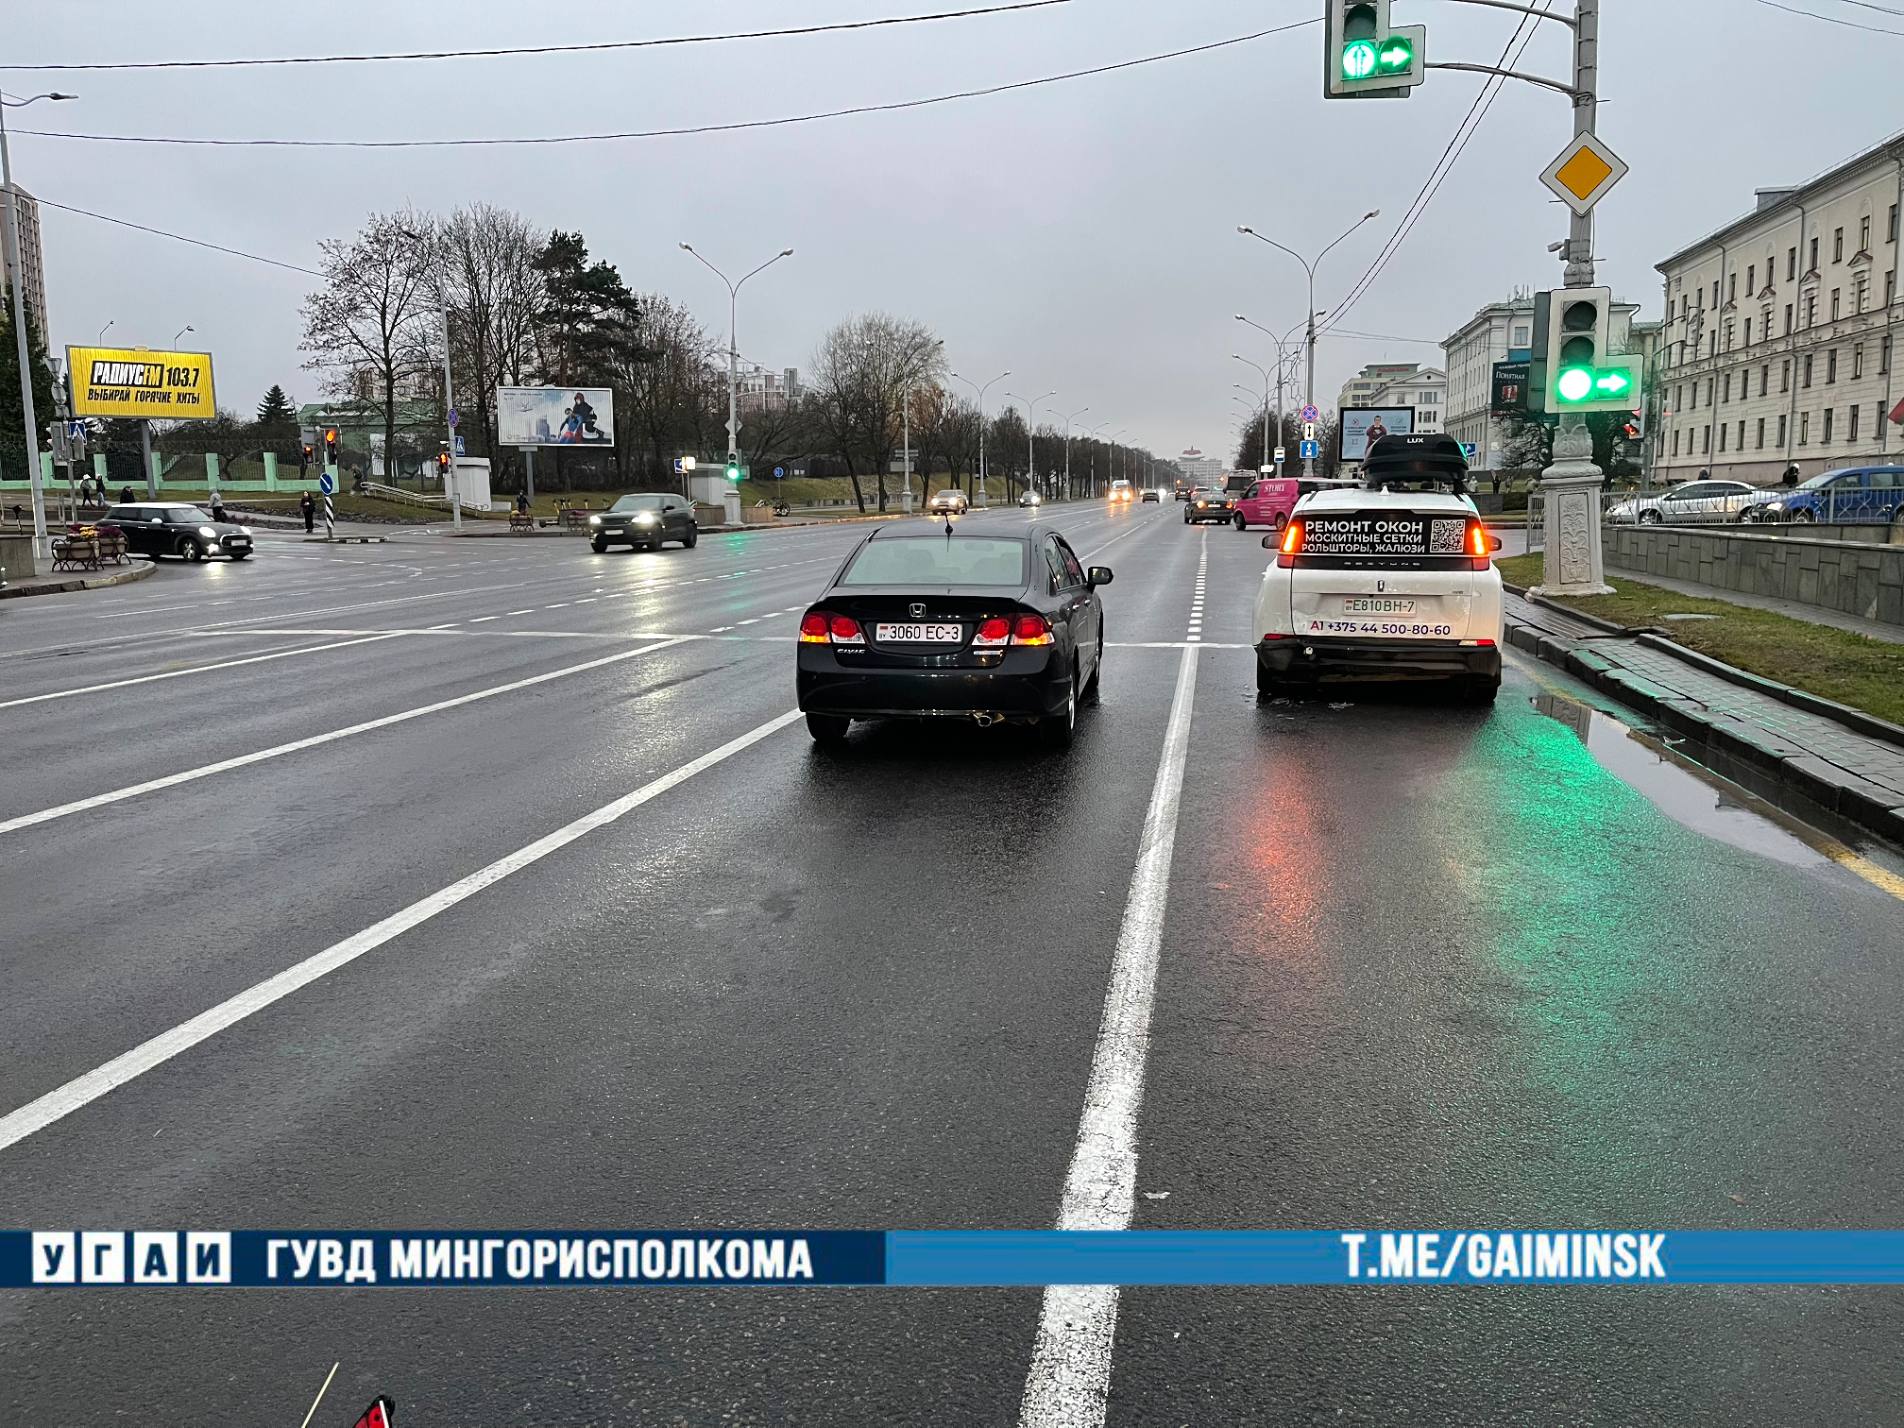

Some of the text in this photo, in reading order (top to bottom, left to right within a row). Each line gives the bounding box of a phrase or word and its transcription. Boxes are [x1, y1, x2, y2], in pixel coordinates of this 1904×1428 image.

[166, 367, 200, 388] 103.7
[88, 387, 200, 405] ВЫБИРАЙ ГОРЯЧИЕ ХИТЫ
[1305, 520, 1423, 533] РЕМОНТ ОКОН
[1305, 533, 1422, 543] МОСКИТНЫЕ СЕТКИ
[1301, 543, 1425, 554] РОЛЬШТОРЫ, ЖАЛЮЗИ
[889, 625, 921, 640] 3060
[926, 625, 960, 640] EC-3
[1310, 620, 1451, 636] A1 +375 44 500-80-60
